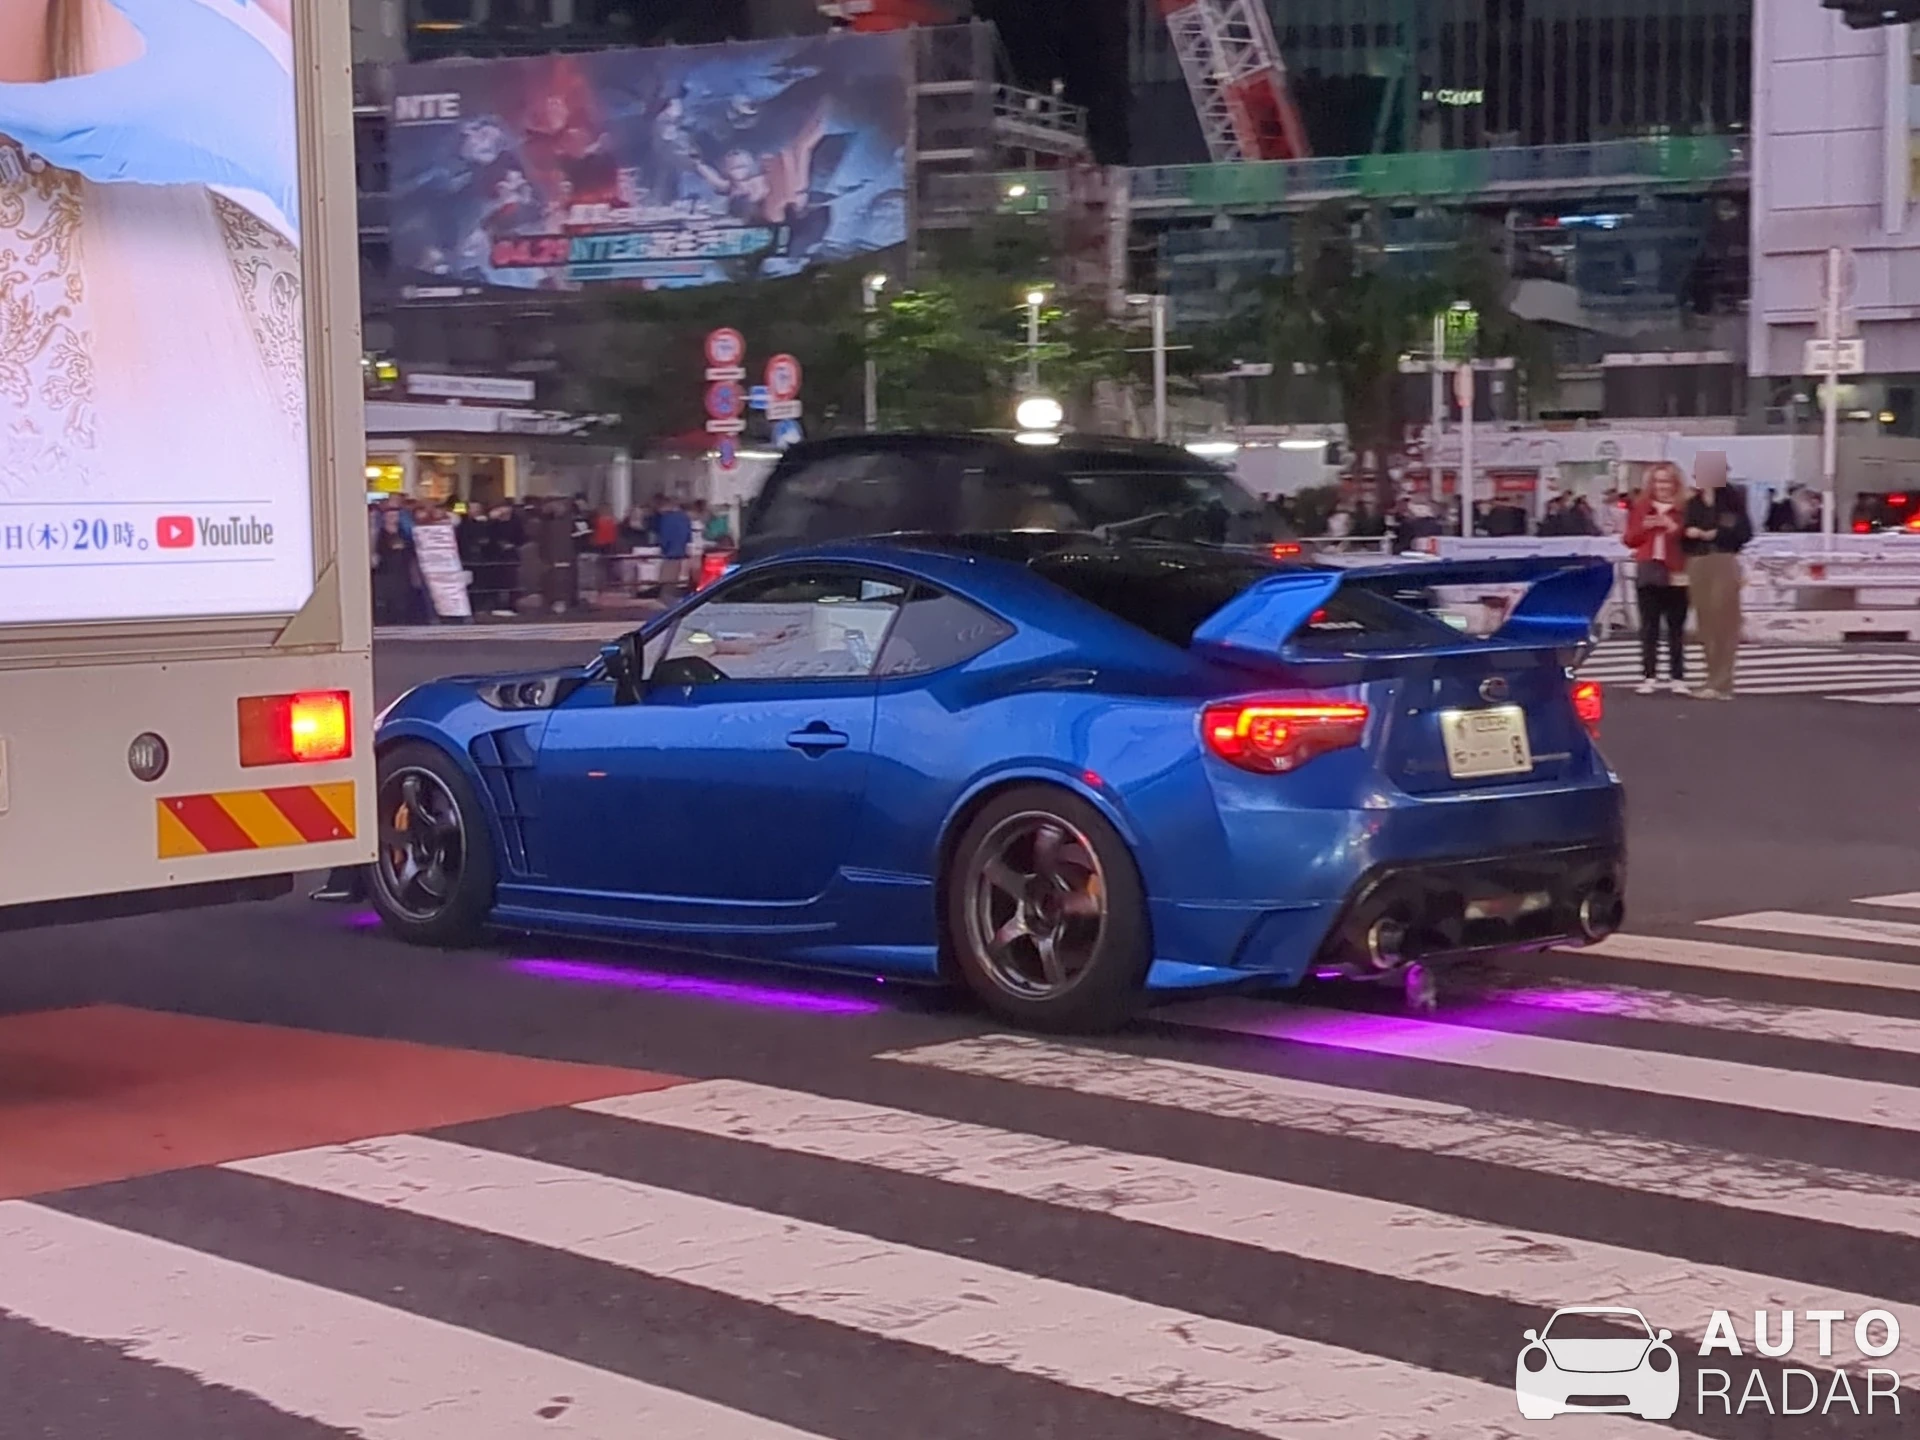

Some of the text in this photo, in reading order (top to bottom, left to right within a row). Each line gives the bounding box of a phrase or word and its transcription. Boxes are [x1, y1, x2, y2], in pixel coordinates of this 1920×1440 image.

[0, 515, 274, 550] 日(木)20時。 YouTube
